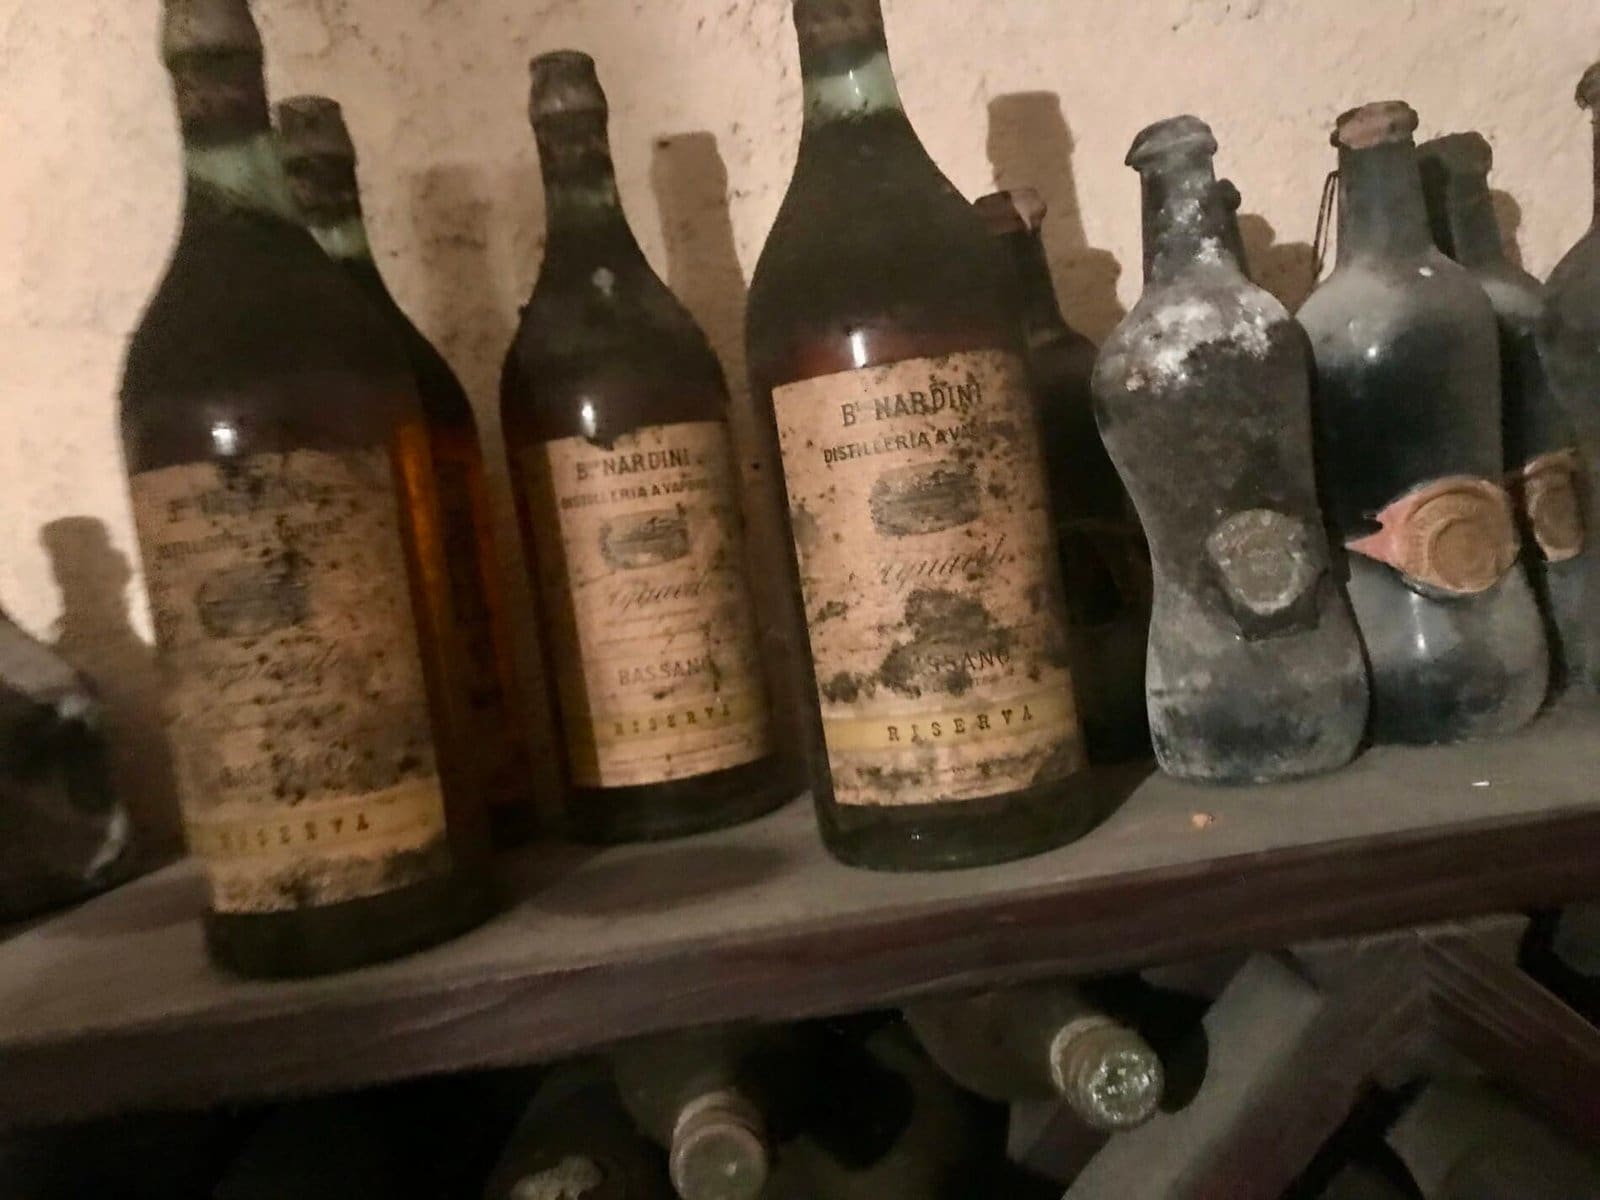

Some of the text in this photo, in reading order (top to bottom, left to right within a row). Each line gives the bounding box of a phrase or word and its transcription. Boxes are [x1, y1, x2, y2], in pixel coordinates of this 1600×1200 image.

[875, 382, 982, 421] NARDINI
[602, 449, 691, 476] NARDINI
[824, 431, 931, 463] DISTILLERIA
[618, 657, 710, 687] BASSAN
[887, 704, 1033, 742] RISERVA
